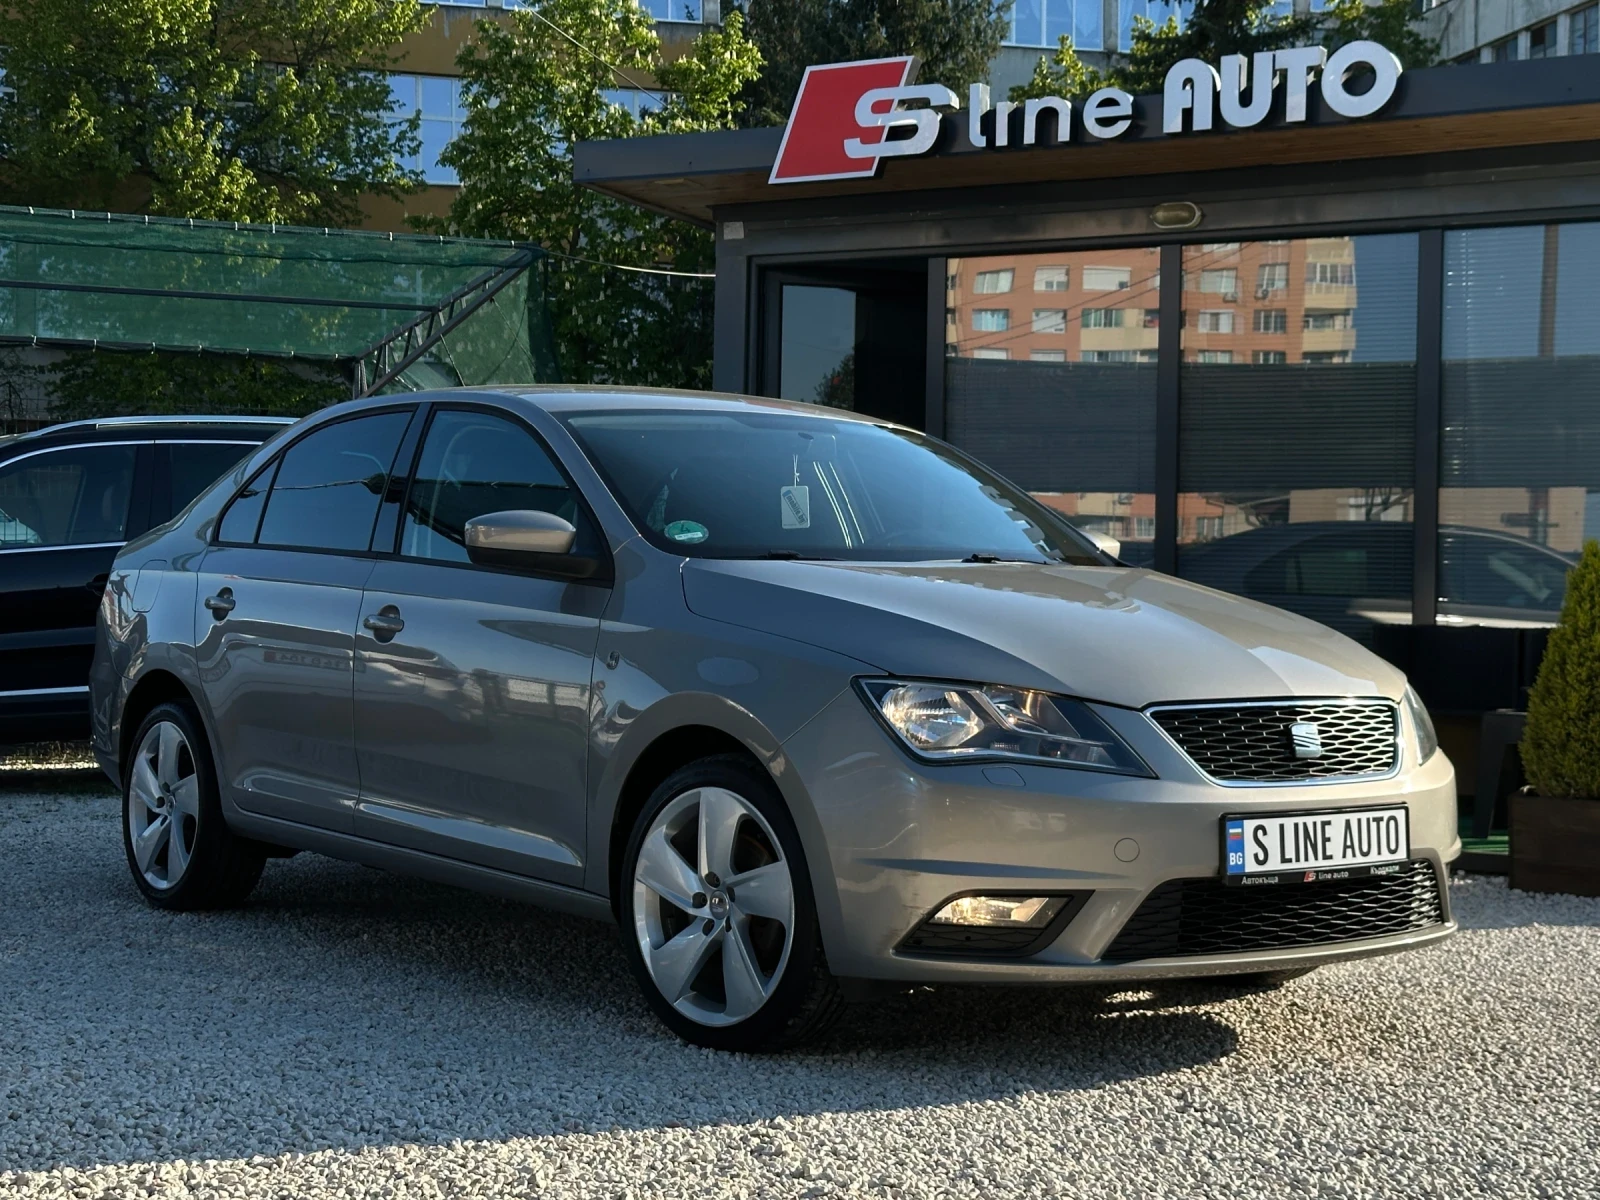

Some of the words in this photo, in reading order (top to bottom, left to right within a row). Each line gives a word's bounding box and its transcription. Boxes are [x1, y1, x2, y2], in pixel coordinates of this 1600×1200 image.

[844, 84, 957, 158] S
[969, 83, 1133, 147] line
[1163, 40, 1400, 133] AUTO
[1252, 824, 1269, 866] S
[1278, 820, 1333, 864] LINE
[1342, 815, 1399, 859] AUTO
[1229, 852, 1243, 866] BG
[1241, 875, 1279, 885] Автокъща
[1318, 872, 1332, 880] line
[1333, 871, 1349, 879] auto
